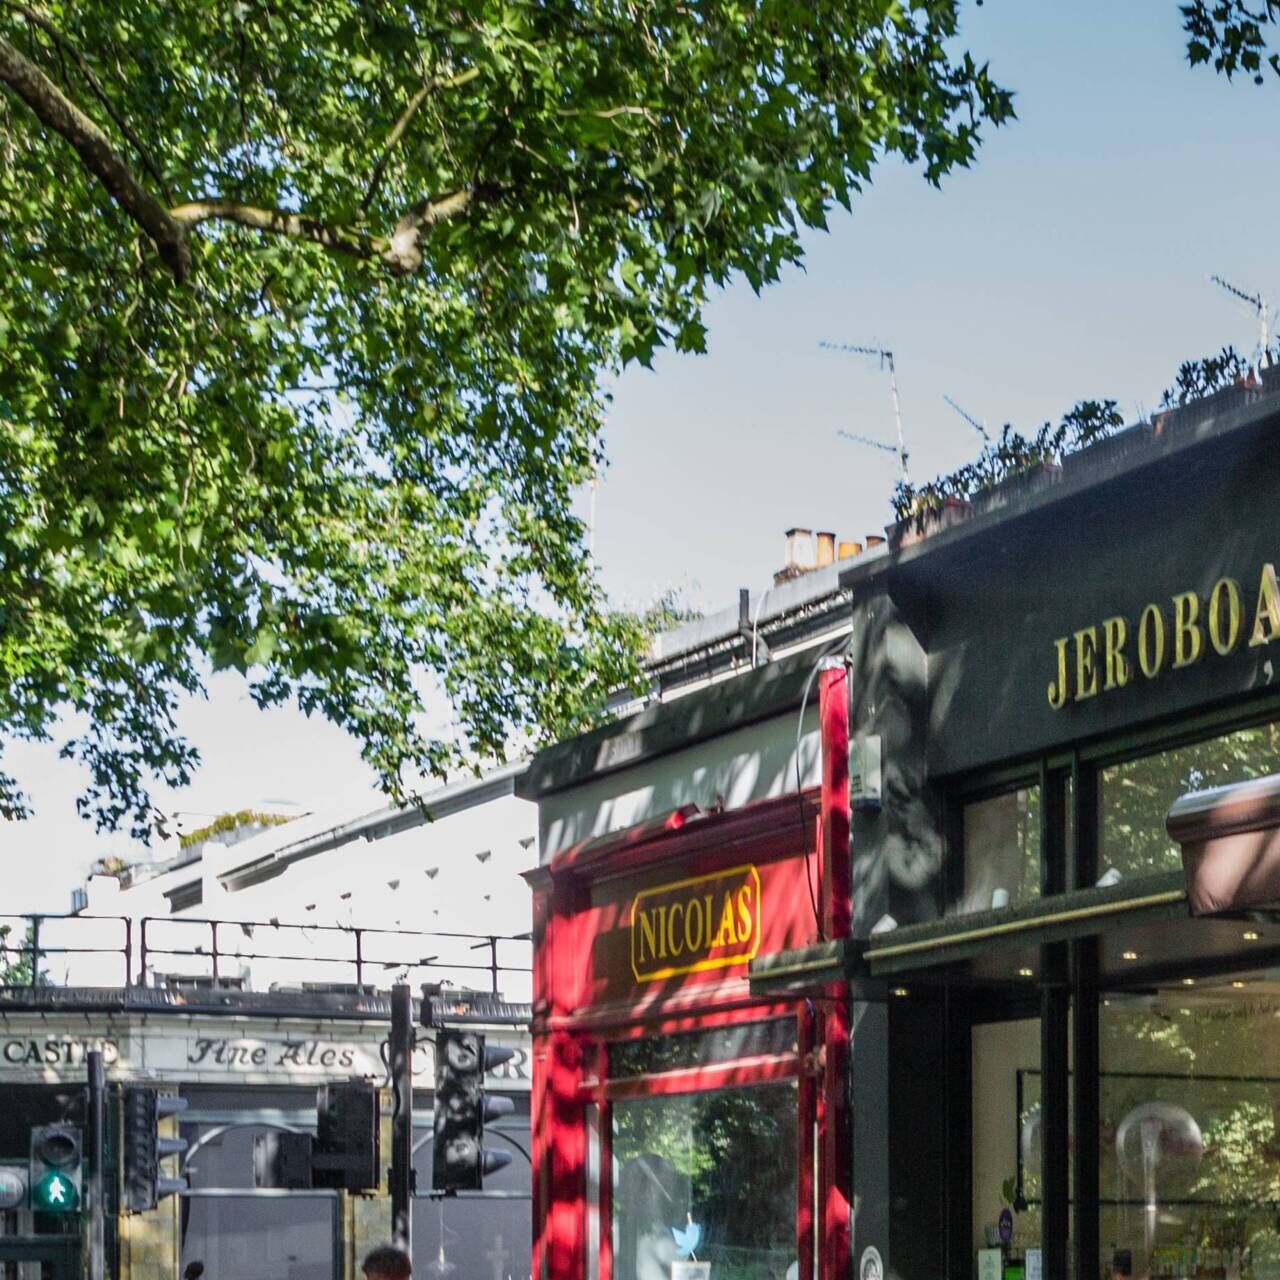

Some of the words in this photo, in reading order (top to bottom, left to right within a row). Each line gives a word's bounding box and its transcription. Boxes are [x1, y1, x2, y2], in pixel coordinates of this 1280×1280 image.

[638, 884, 753, 963] NICOLAS
[188, 1037, 267, 1066] Fine
[276, 1039, 354, 1068] Ales
